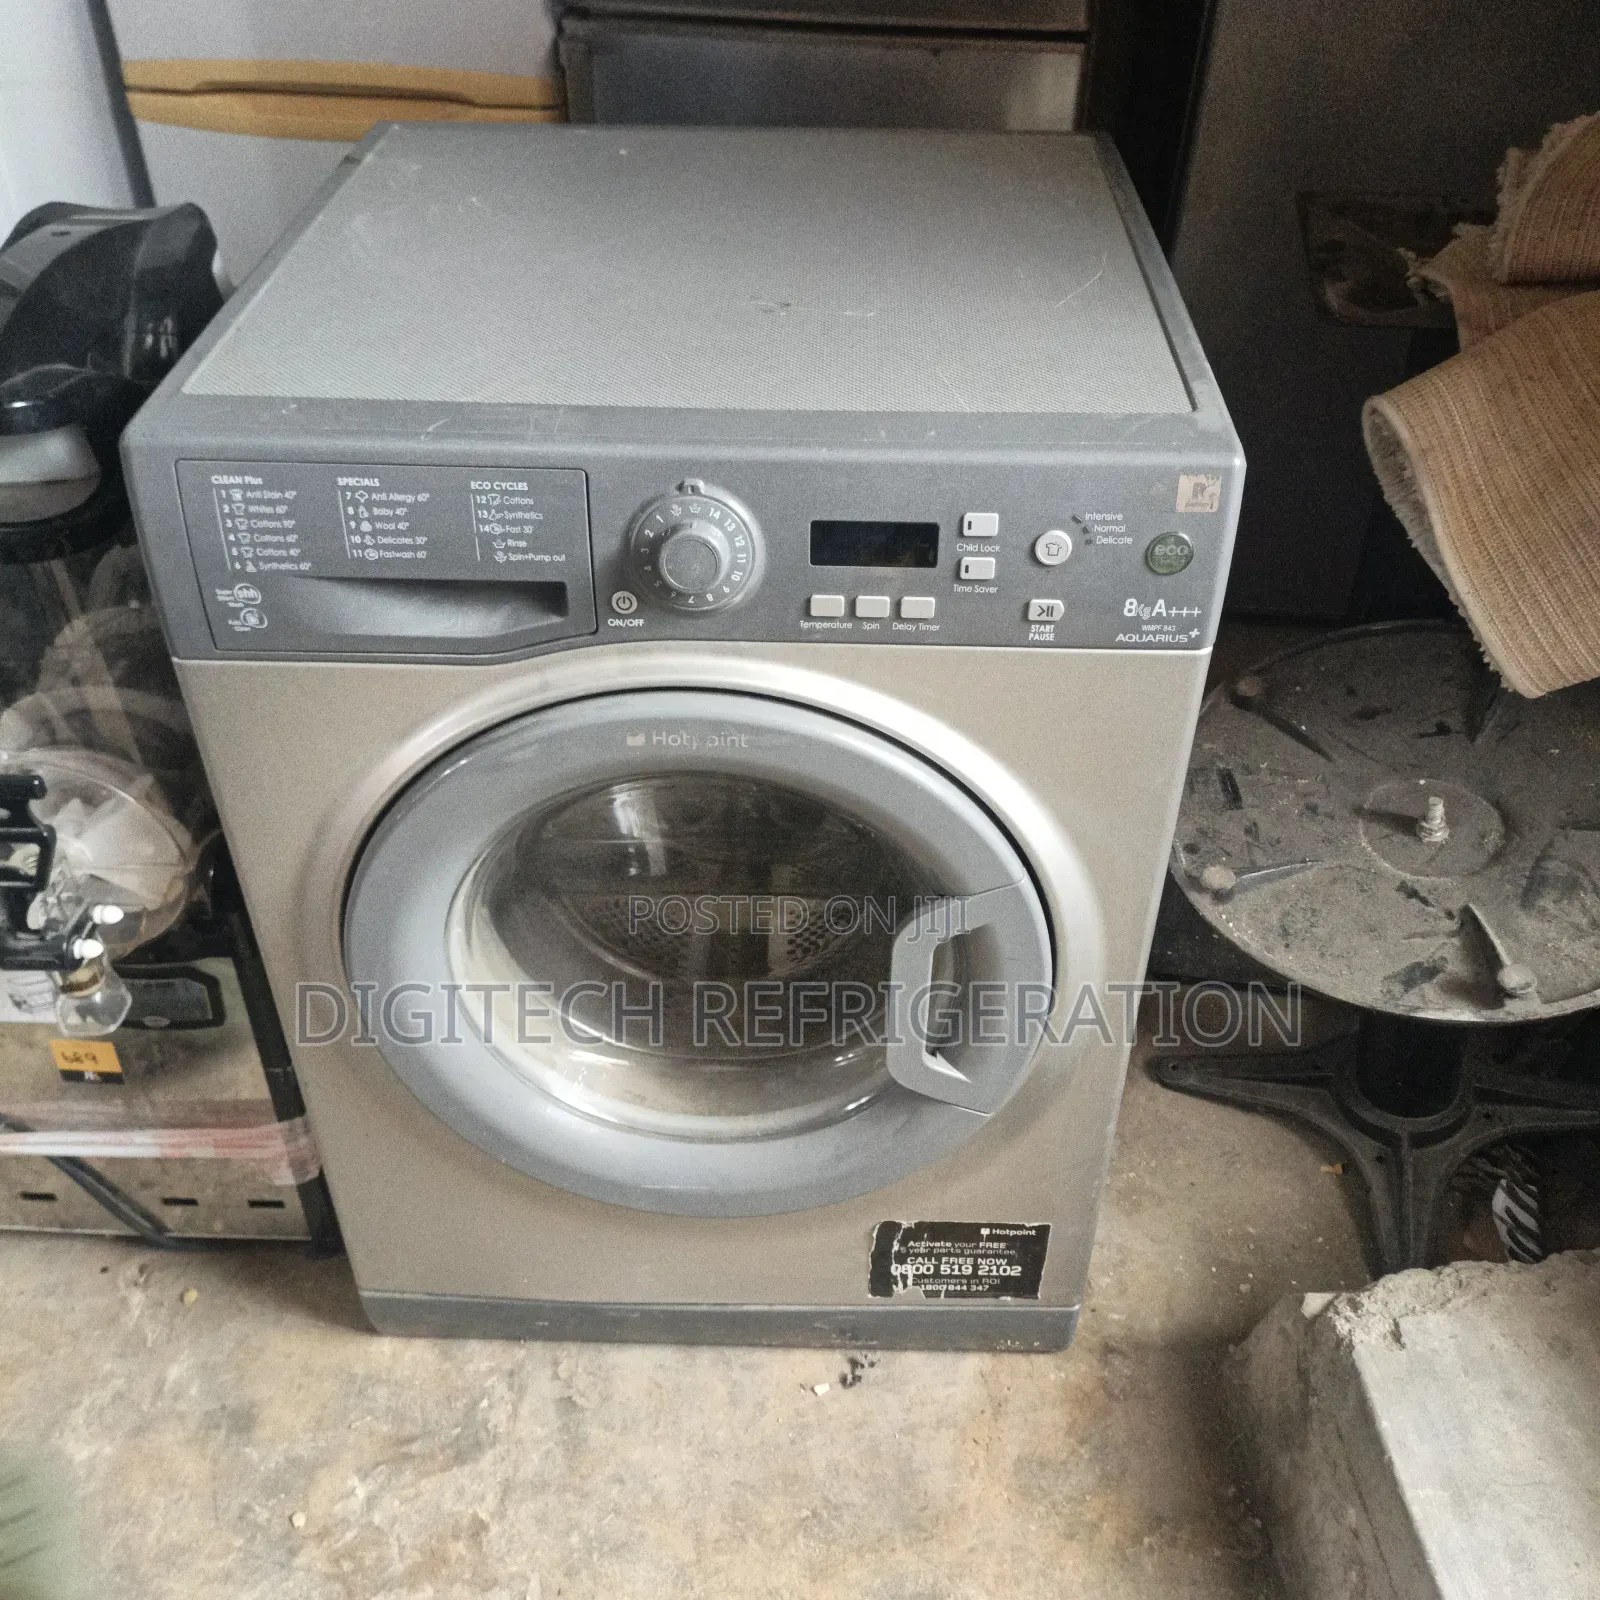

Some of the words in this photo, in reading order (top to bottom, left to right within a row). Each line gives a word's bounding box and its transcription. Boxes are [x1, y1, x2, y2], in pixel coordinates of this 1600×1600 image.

[211, 475, 243, 485] CLEAN
[244, 476, 263, 485] Plus
[337, 477, 380, 487] SPECIALS
[470, 481, 491, 490] ECO
[493, 482, 528, 491] CYCLES
[345, 491, 352, 500] 7
[389, 493, 415, 503] Allergy
[476, 495, 487, 504] 12
[503, 496, 534, 505] Cottons
[223, 504, 230, 513] 2
[372, 507, 394, 517] Baby
[708, 507, 721, 520] 14
[477, 510, 489, 518] 13
[503, 510, 543, 520] Synthetics
[655, 514, 664, 524] 1
[1085, 512, 1123, 521] Intensive
[250, 520, 282, 528] Cottons
[375, 521, 396, 530] Wool
[479, 524, 489, 533] 14
[505, 525, 521, 534] Fast
[723, 518, 736, 532] 13
[1094, 524, 1126, 533] Normal
[253, 534, 285, 543] Cottons
[644, 529, 655, 538] 2
[350, 535, 362, 544] 10
[377, 536, 414, 545] Delicates
[507, 539, 528, 548] Rinse
[733, 530, 746, 548] 12
[1096, 536, 1133, 545] Delicate
[256, 548, 288, 556] Cottons
[956, 543, 978, 552] Child
[980, 543, 1000, 553] Lock
[1154, 544, 1189, 556] eco
[352, 549, 363, 558] 11
[379, 550, 416, 559] Fastwash
[508, 552, 552, 562] Spin+Pump
[552, 554, 566, 562] out
[736, 552, 747, 563] 11
[259, 561, 299, 571] Synthetics
[730, 570, 743, 582] 10
[953, 584, 973, 594] Time
[974, 585, 999, 594] Saver
[607, 618, 645, 627] ON/OFF
[800, 620, 853, 630] Temperature
[862, 622, 880, 631] Spin
[892, 622, 917, 633] Delay
[918, 622, 941, 632] Timer
[1030, 624, 1055, 633] START
[1141, 624, 1163, 632] WMPF
[1163, 624, 1177, 632] 843
[1028, 633, 1055, 642] PAUSE
[992, 1228, 1037, 1236] Hotpoint
[907, 1240, 952, 1248] Activate
[979, 1241, 1007, 1249] FREE
[909, 1247, 930, 1255] year
[963, 1248, 1016, 1256] guarantee
[906, 1256, 939, 1265] CALL
[941, 1257, 974, 1265] FREE
[977, 1257, 1008, 1266] NOW
[890, 1263, 934, 1276] 0800
[940, 1264, 973, 1276] 519
[977, 1265, 1022, 1277] 2102
[911, 1277, 968, 1285] Customers
[982, 1277, 1001, 1285] ROI
[920, 1283, 947, 1291] 1800
[970, 1284, 990, 1292] 347
